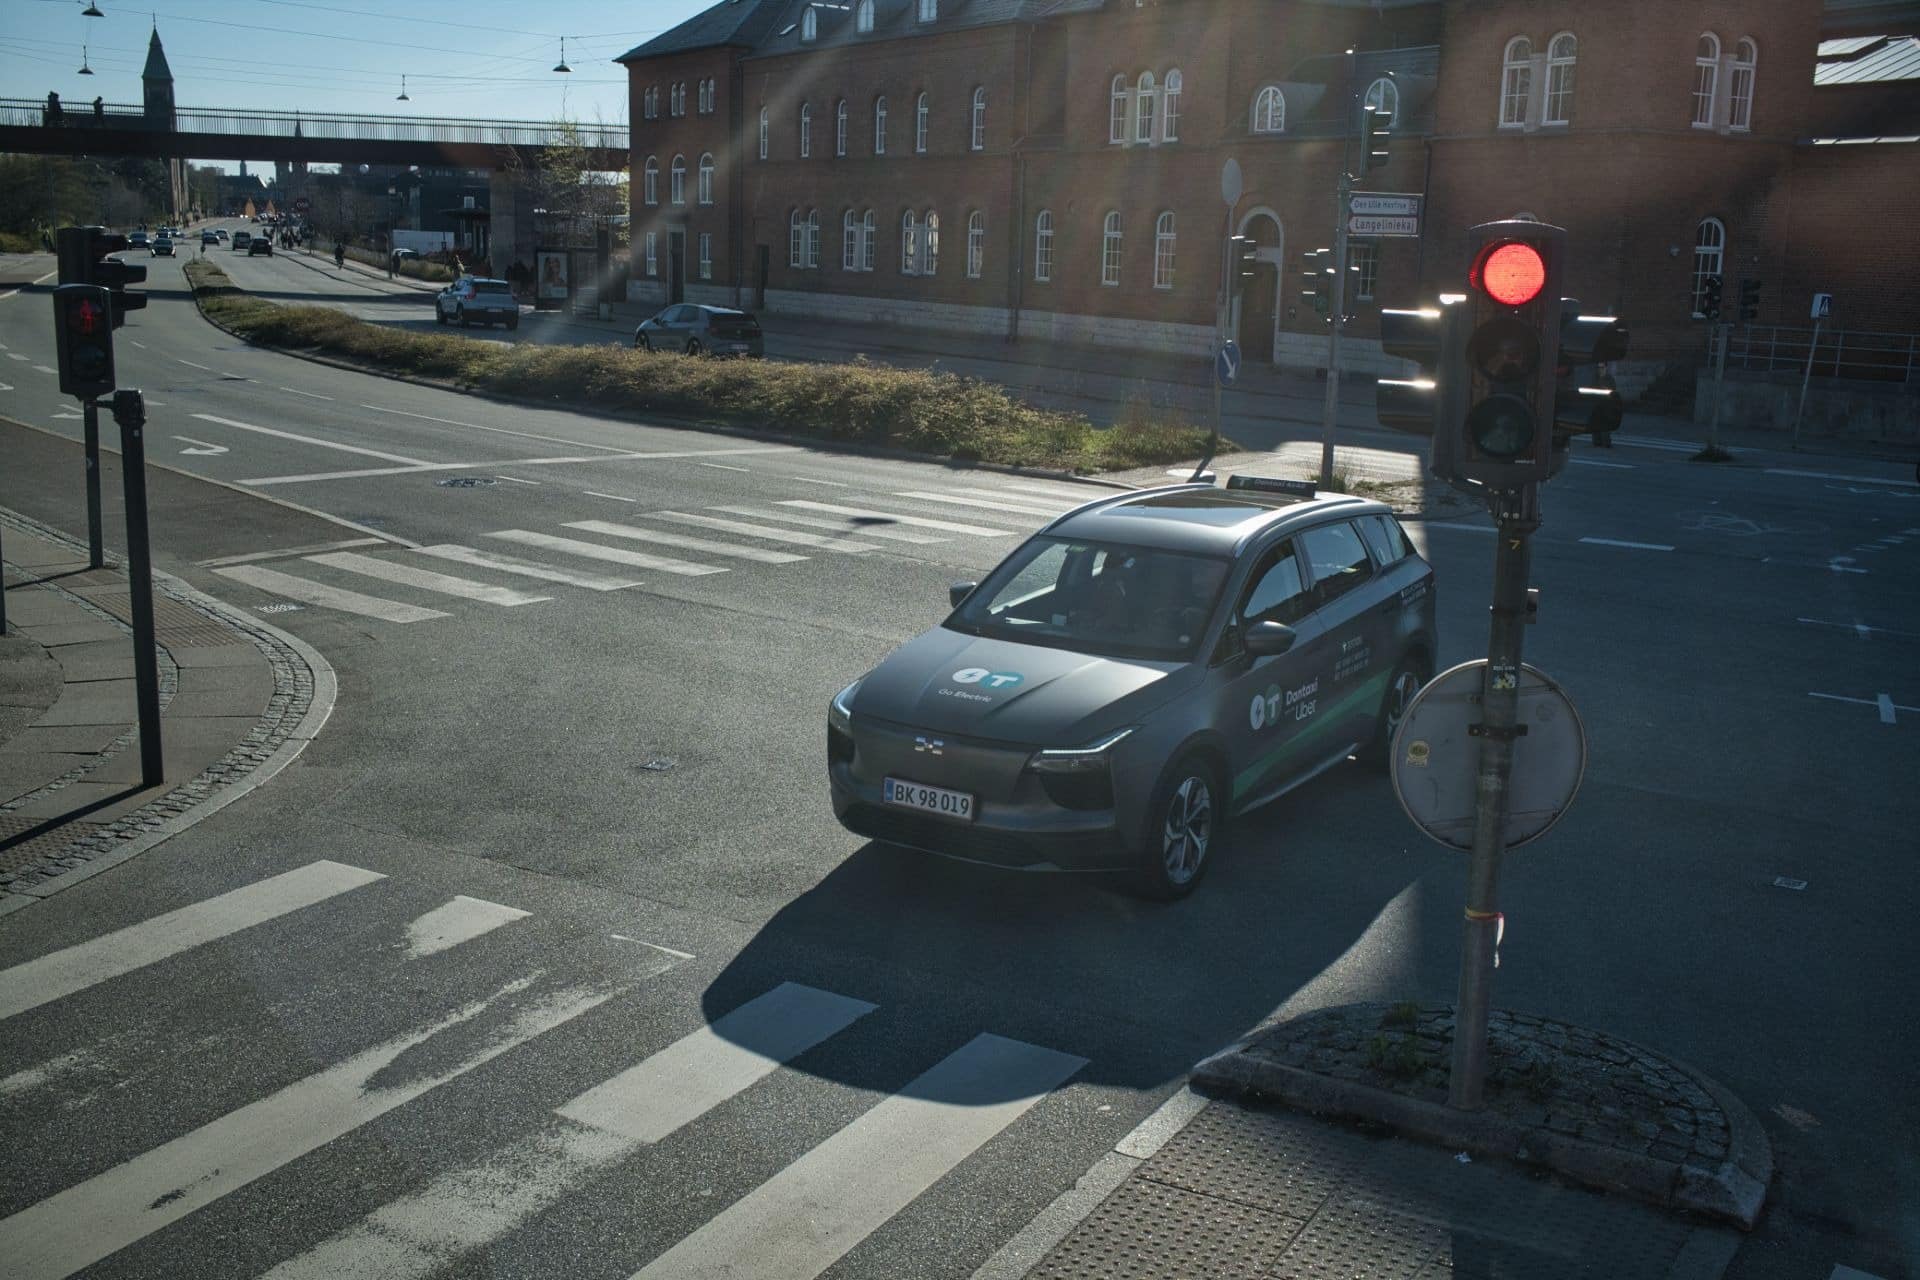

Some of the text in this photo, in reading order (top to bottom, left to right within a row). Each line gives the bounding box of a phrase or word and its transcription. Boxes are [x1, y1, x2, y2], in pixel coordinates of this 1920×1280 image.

[1355, 218, 1414, 232] Langeliniekaj
[991, 675, 1019, 687] T
[938, 688, 992, 703] Go Electric
[1286, 675, 1319, 706] Dantaxi
[1296, 699, 1317, 721] Uber
[895, 783, 969, 815] BK 98 019
